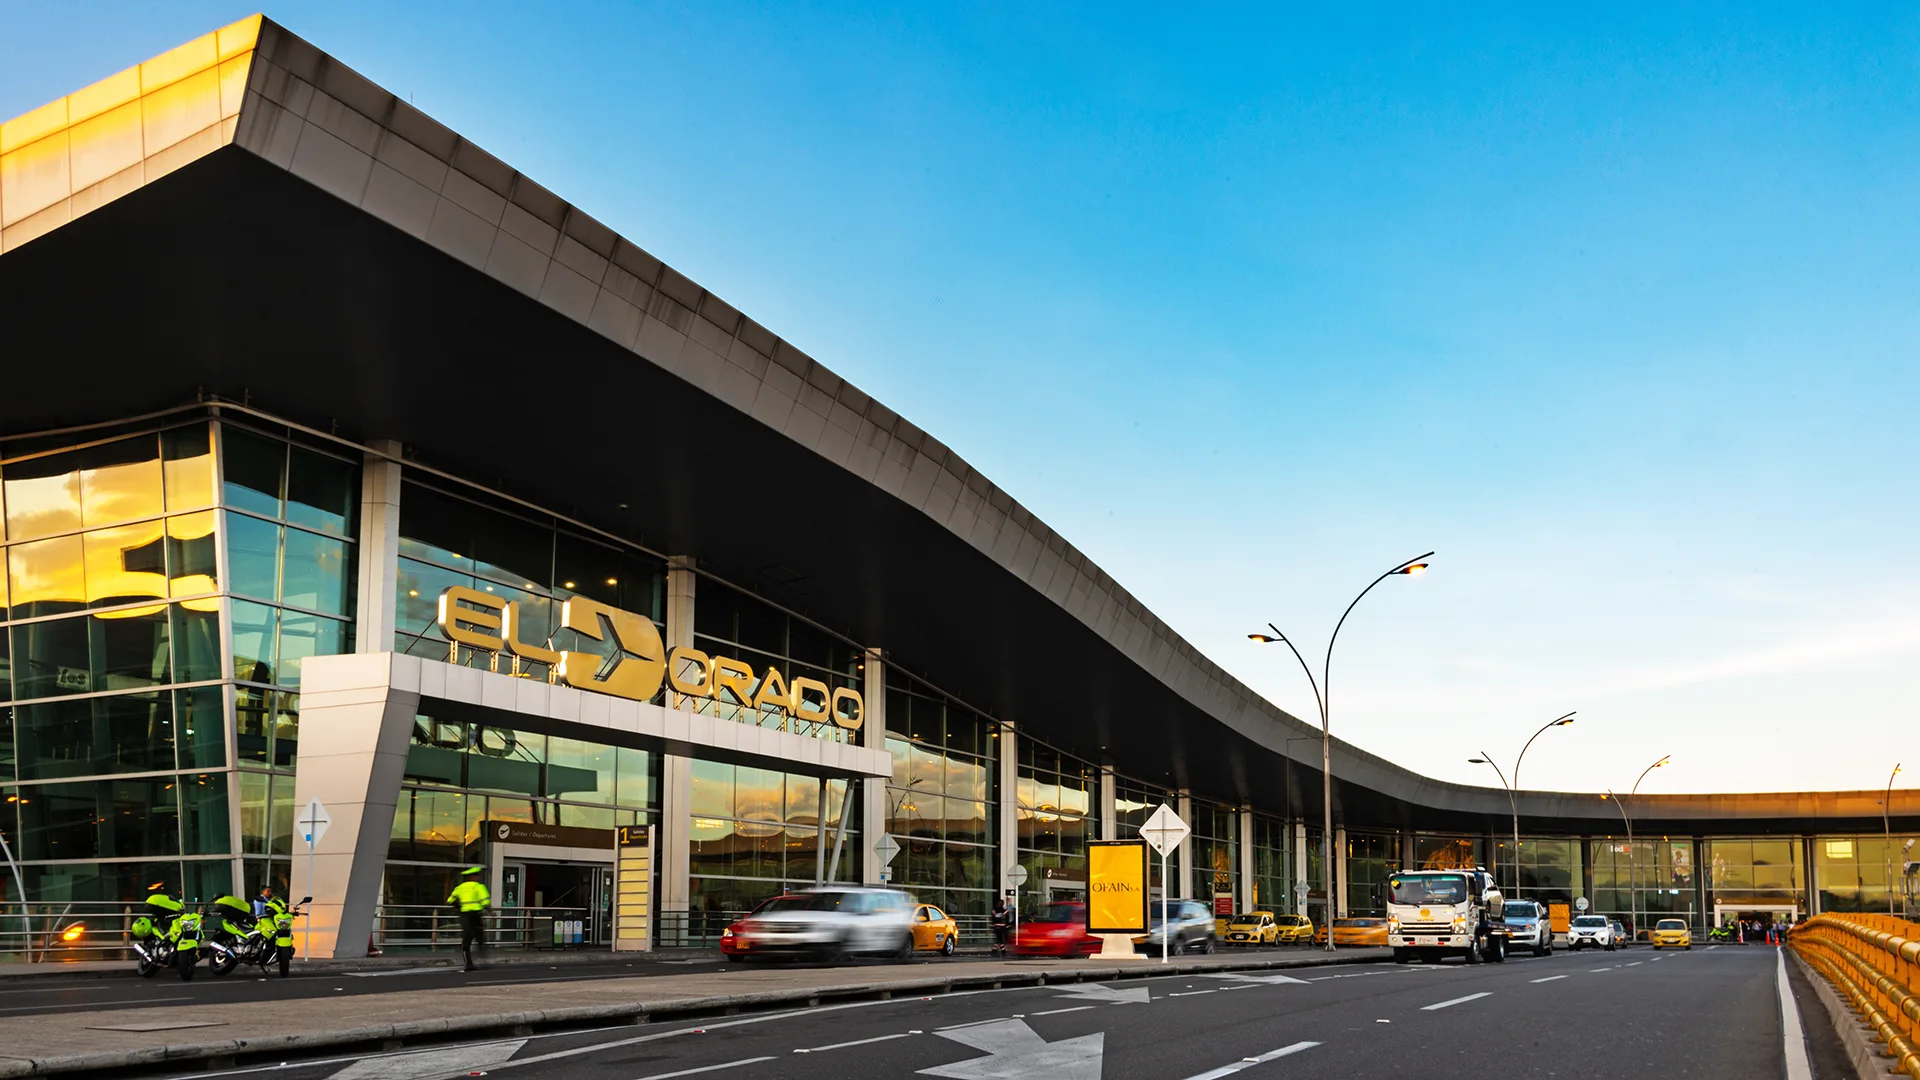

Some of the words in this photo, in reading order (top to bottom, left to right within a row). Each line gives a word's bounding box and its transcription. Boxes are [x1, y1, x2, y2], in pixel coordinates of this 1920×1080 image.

[438, 585, 561, 664] EL
[532, 831, 557, 839] Departures
[620, 827, 630, 844] 1
